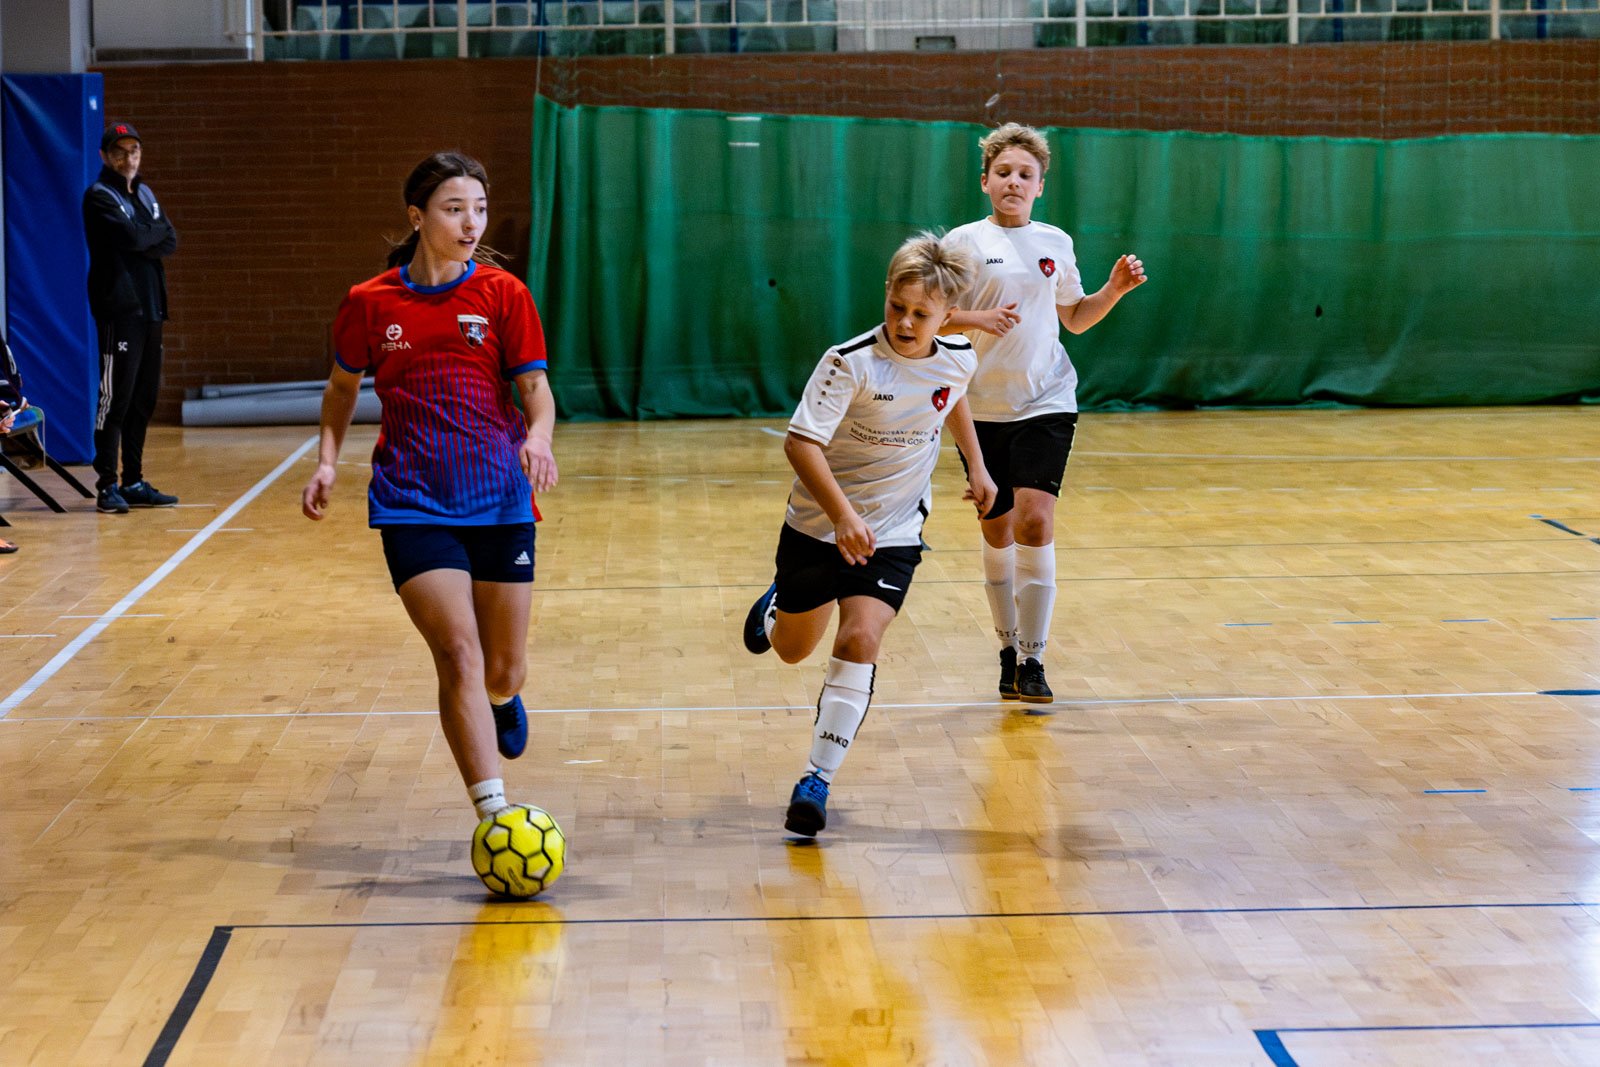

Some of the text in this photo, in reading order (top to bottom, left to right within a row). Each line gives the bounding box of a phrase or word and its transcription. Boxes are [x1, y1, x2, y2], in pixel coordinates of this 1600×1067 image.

[118, 341, 128, 351] SC
[381, 341, 412, 351] PEHA
[872, 393, 894, 402] JAKO
[819, 730, 849, 748] JAKO
